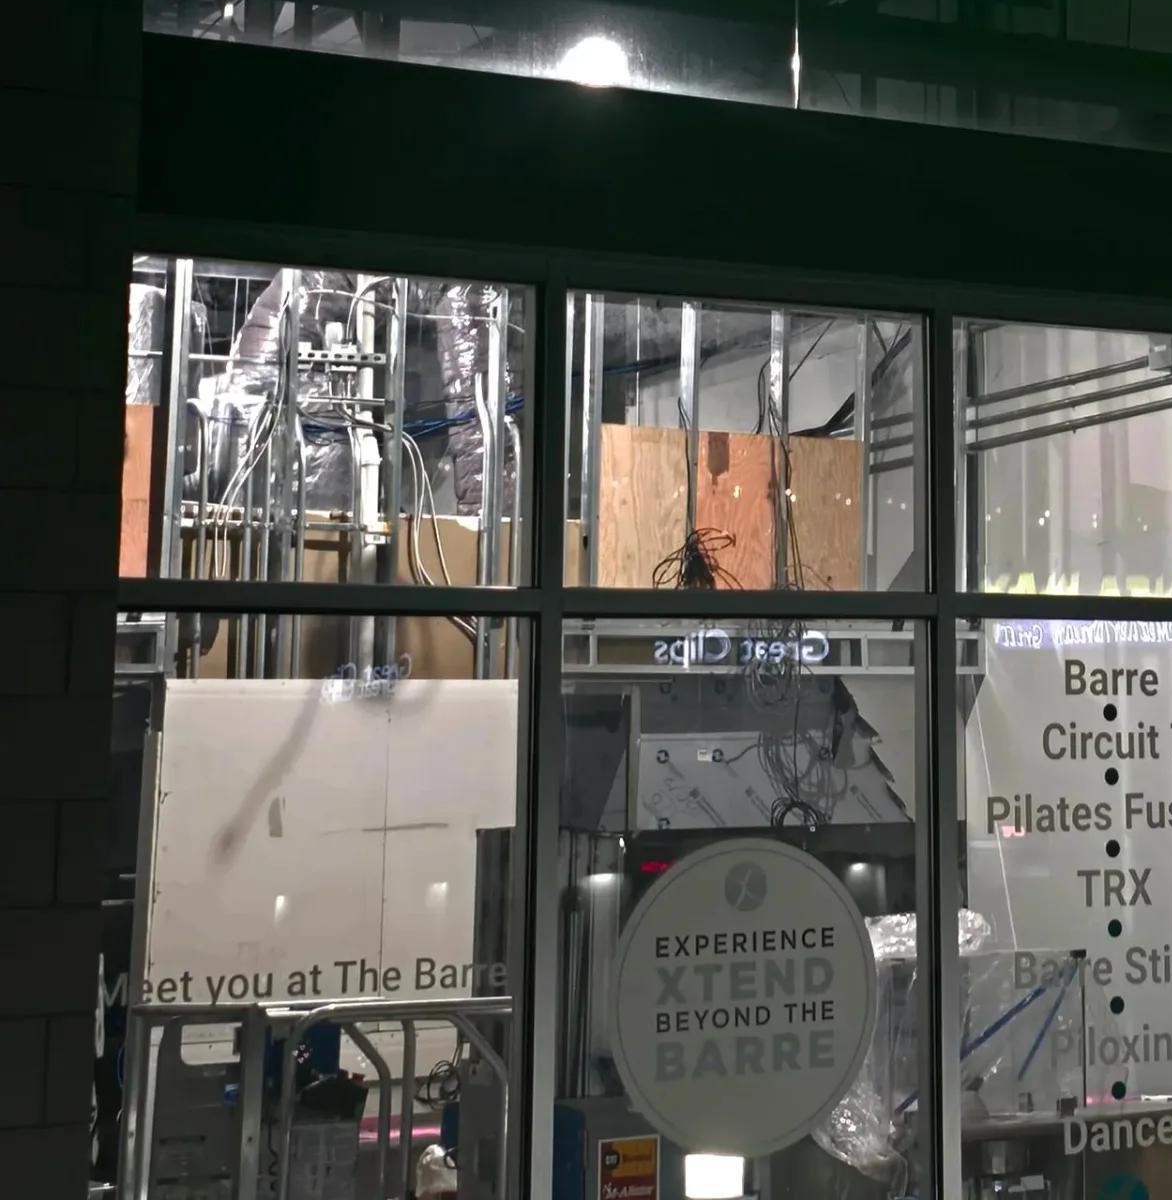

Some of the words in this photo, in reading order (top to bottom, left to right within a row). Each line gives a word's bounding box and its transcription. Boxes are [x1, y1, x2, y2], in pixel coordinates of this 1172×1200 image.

[1065, 660, 1159, 696] Barre
[1043, 722, 1160, 760] Circuit
[987, 794, 1112, 834] Pilates
[1077, 868, 1152, 907] TRX
[655, 927, 835, 959] EXPERIENCE
[206, 972, 273, 1006] you
[287, 964, 322, 996] at
[334, 960, 401, 992] The
[414, 957, 508, 990] Barre
[655, 957, 834, 1006] XTEND
[655, 1005, 771, 1033] BEYOND
[785, 1000, 834, 1023] THE
[655, 1029, 835, 1082] BARRE
